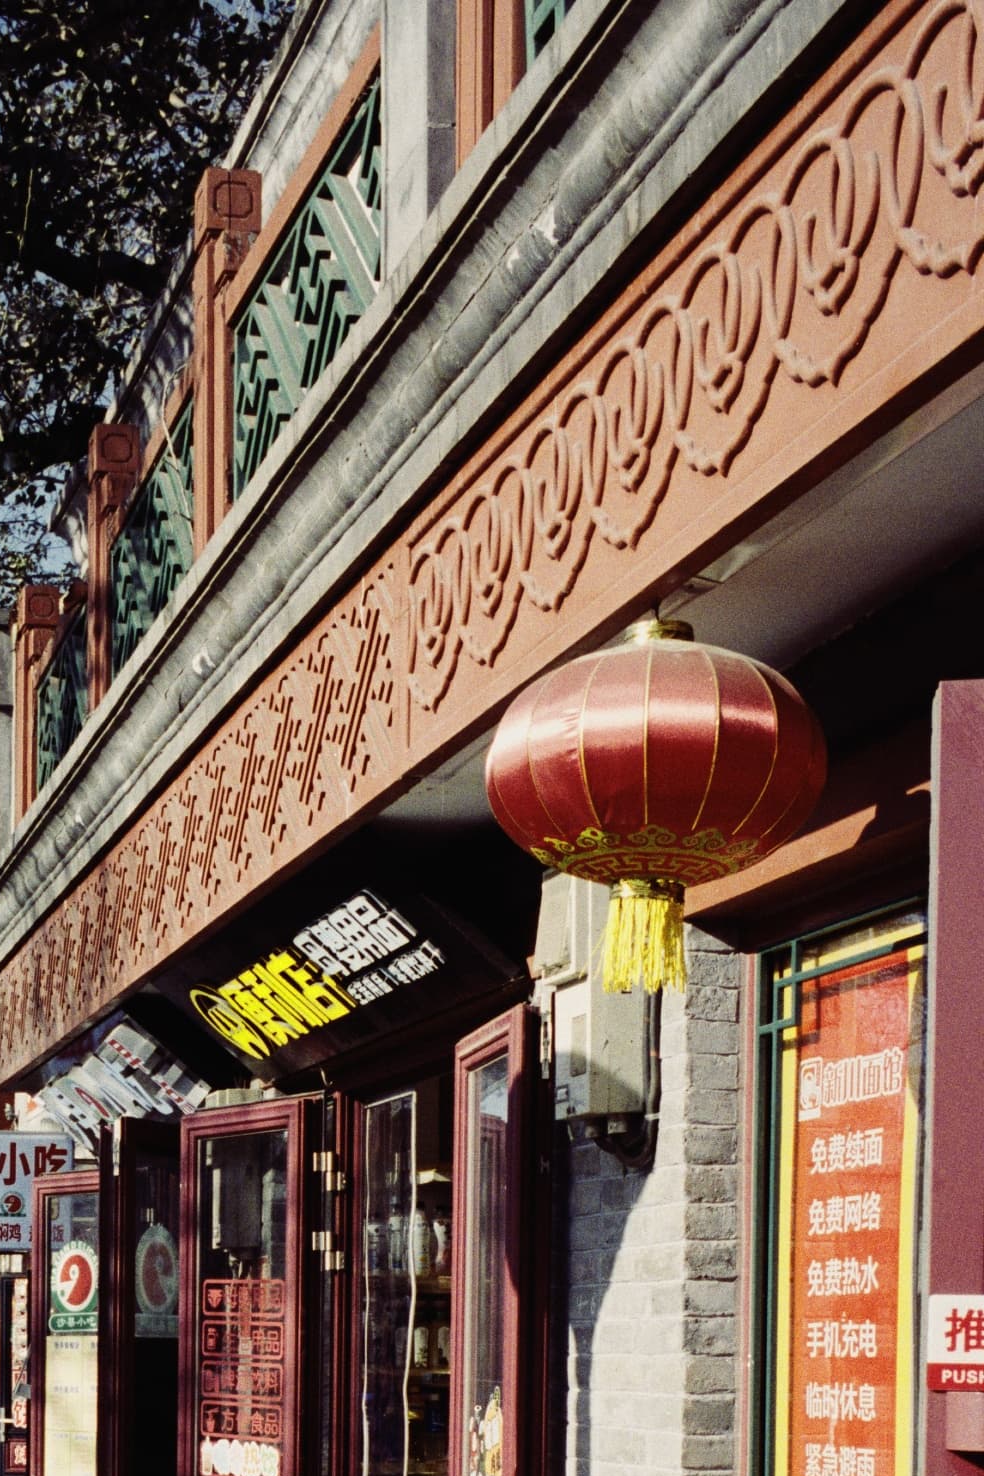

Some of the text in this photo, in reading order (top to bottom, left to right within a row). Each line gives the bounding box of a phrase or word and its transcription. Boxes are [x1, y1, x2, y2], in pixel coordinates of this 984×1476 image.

[822, 1048, 904, 1106] 新川面馆
[809, 1127, 884, 1174] 免费续面
[807, 1192, 881, 1236] 免费网络
[807, 1257, 879, 1298] 免费热水
[805, 1322, 878, 1360] 手机充电
[945, 1308, 984, 1353] 推
[805, 1381, 876, 1421] 临时休息
